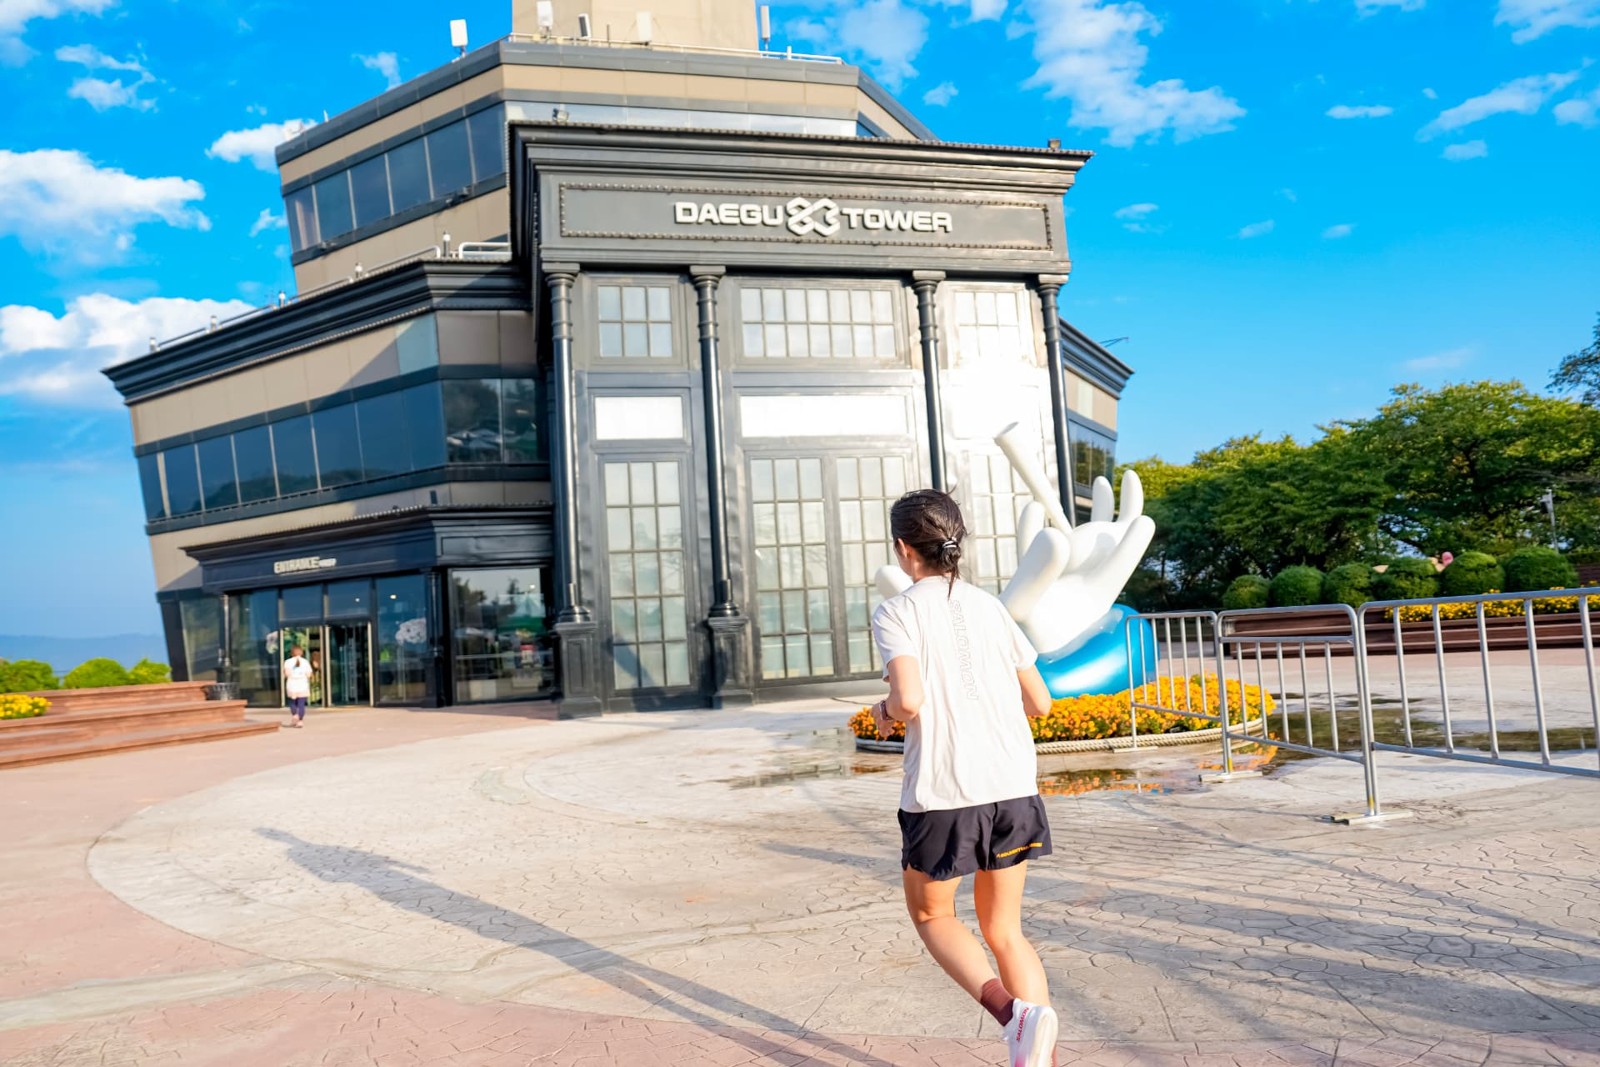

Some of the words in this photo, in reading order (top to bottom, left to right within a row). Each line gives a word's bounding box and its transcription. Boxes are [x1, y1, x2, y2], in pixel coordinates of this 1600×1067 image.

[674, 201, 784, 226] DAEGU
[841, 207, 953, 232] TOWER
[949, 599, 979, 701] SALOMON
